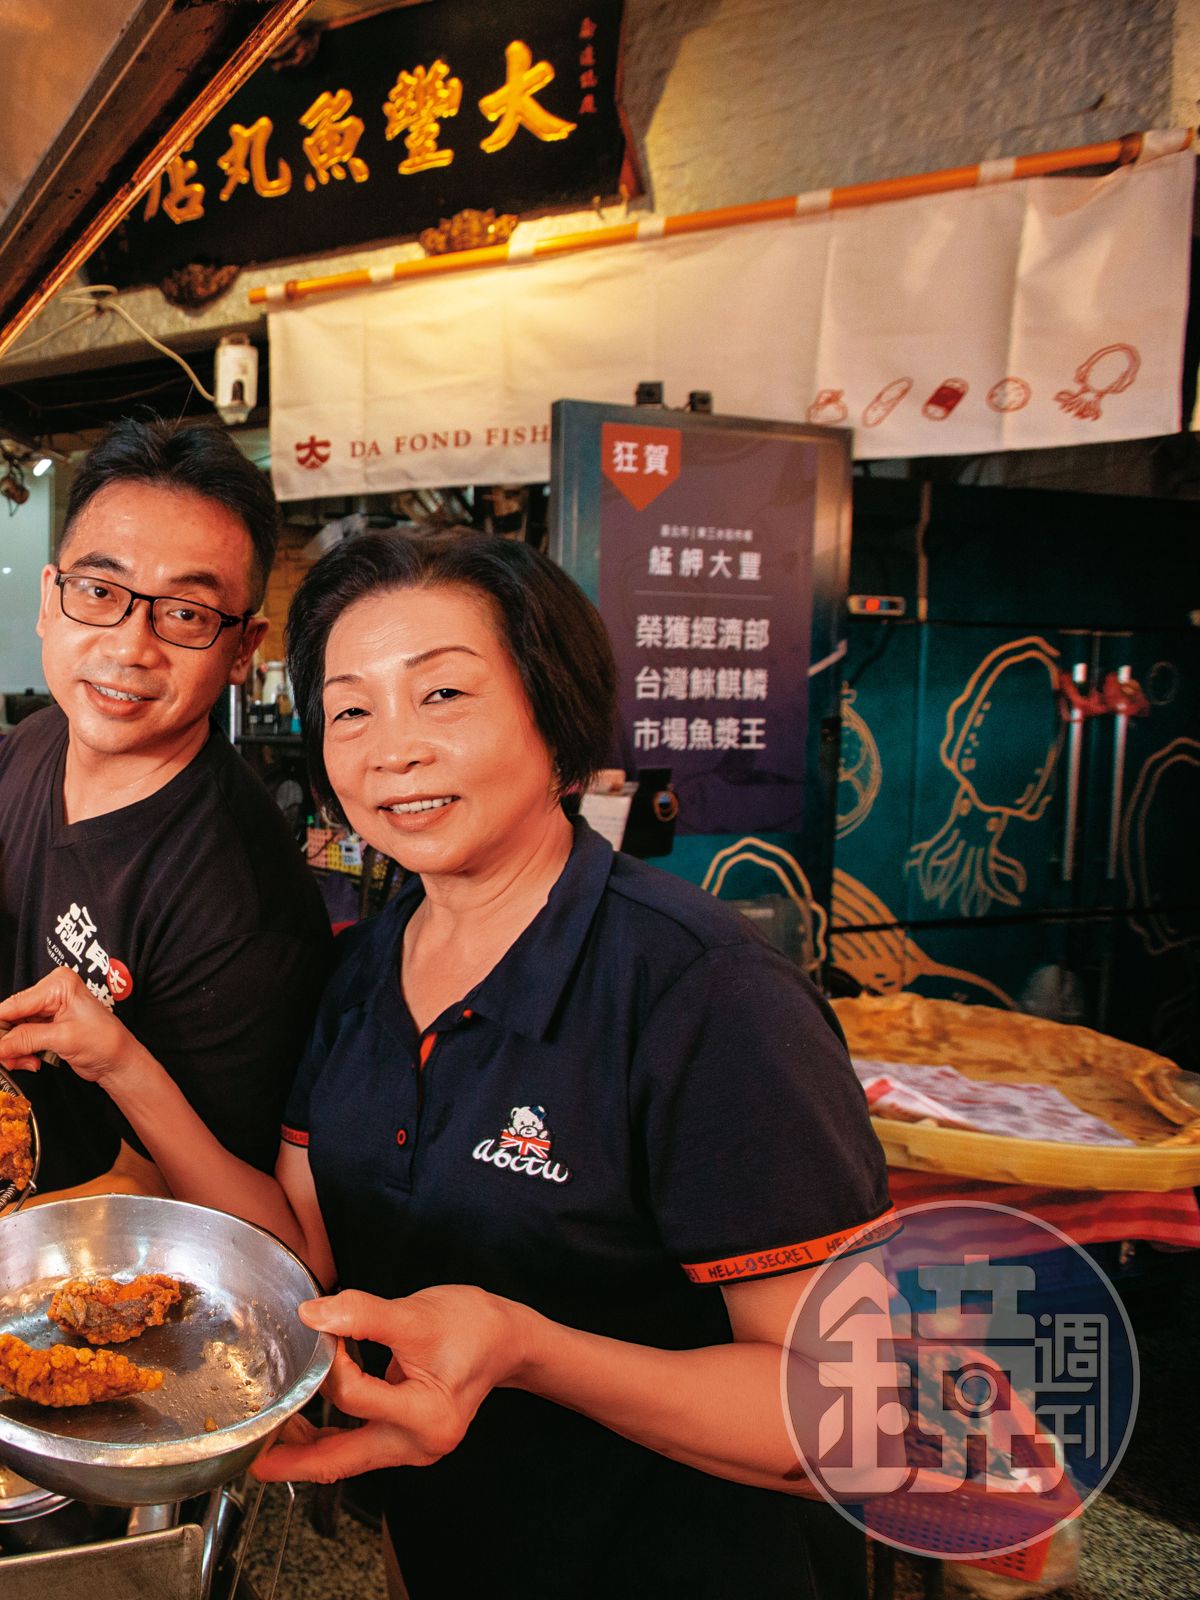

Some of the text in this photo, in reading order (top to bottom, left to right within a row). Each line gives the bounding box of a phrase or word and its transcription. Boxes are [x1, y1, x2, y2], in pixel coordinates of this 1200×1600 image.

[350, 440, 382, 459] DA
[394, 428, 472, 455] FOND
[485, 423, 551, 447] FISH
[612, 441, 670, 476] 狂賀
[648, 545, 762, 581] 艋舺大豐
[635, 613, 771, 651] 榮獲經濟部
[633, 716, 767, 751] 市場魚漿王
